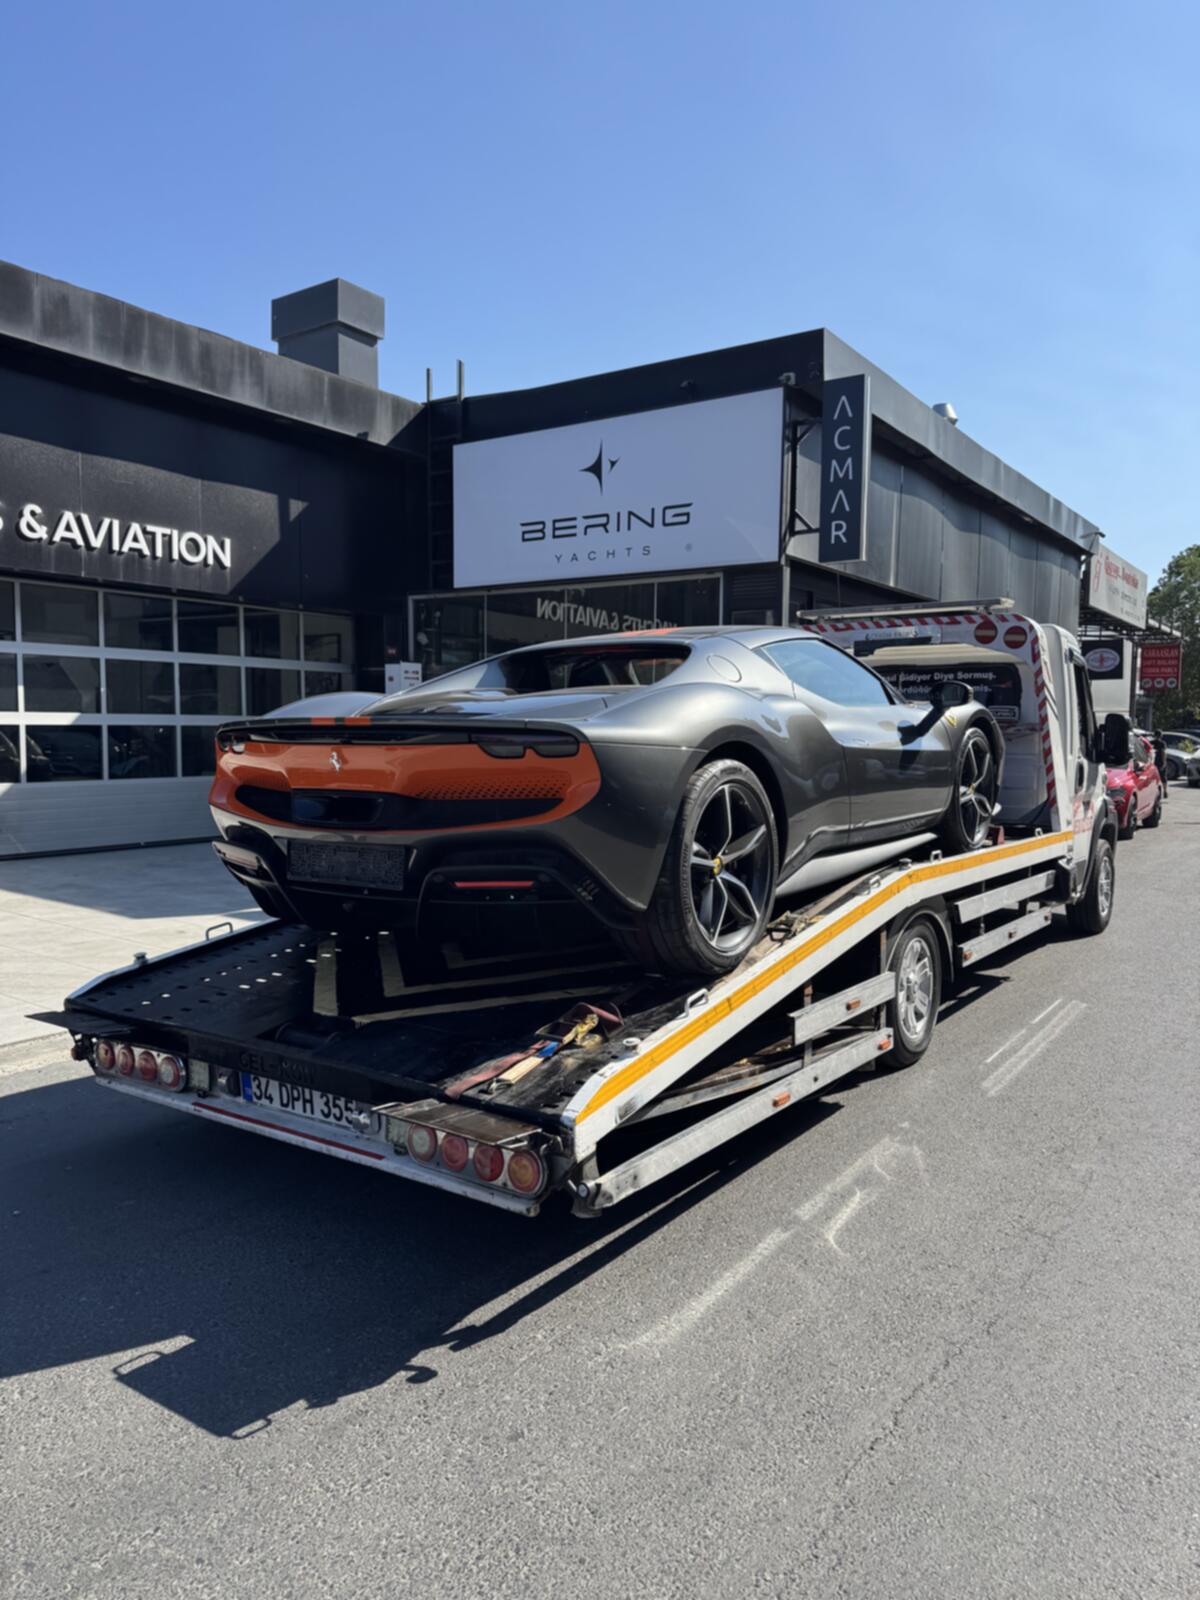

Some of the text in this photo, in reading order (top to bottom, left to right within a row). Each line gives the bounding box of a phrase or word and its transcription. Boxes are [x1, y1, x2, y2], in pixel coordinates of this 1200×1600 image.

[19, 503, 48, 541] &
[52, 510, 231, 568] AVIATION
[520, 502, 694, 543] BERING
[555, 545, 651, 564] YACHTS
[933, 671, 954, 682] Diye
[252, 1076, 274, 1105] 34
[279, 1082, 315, 1116] DPH
